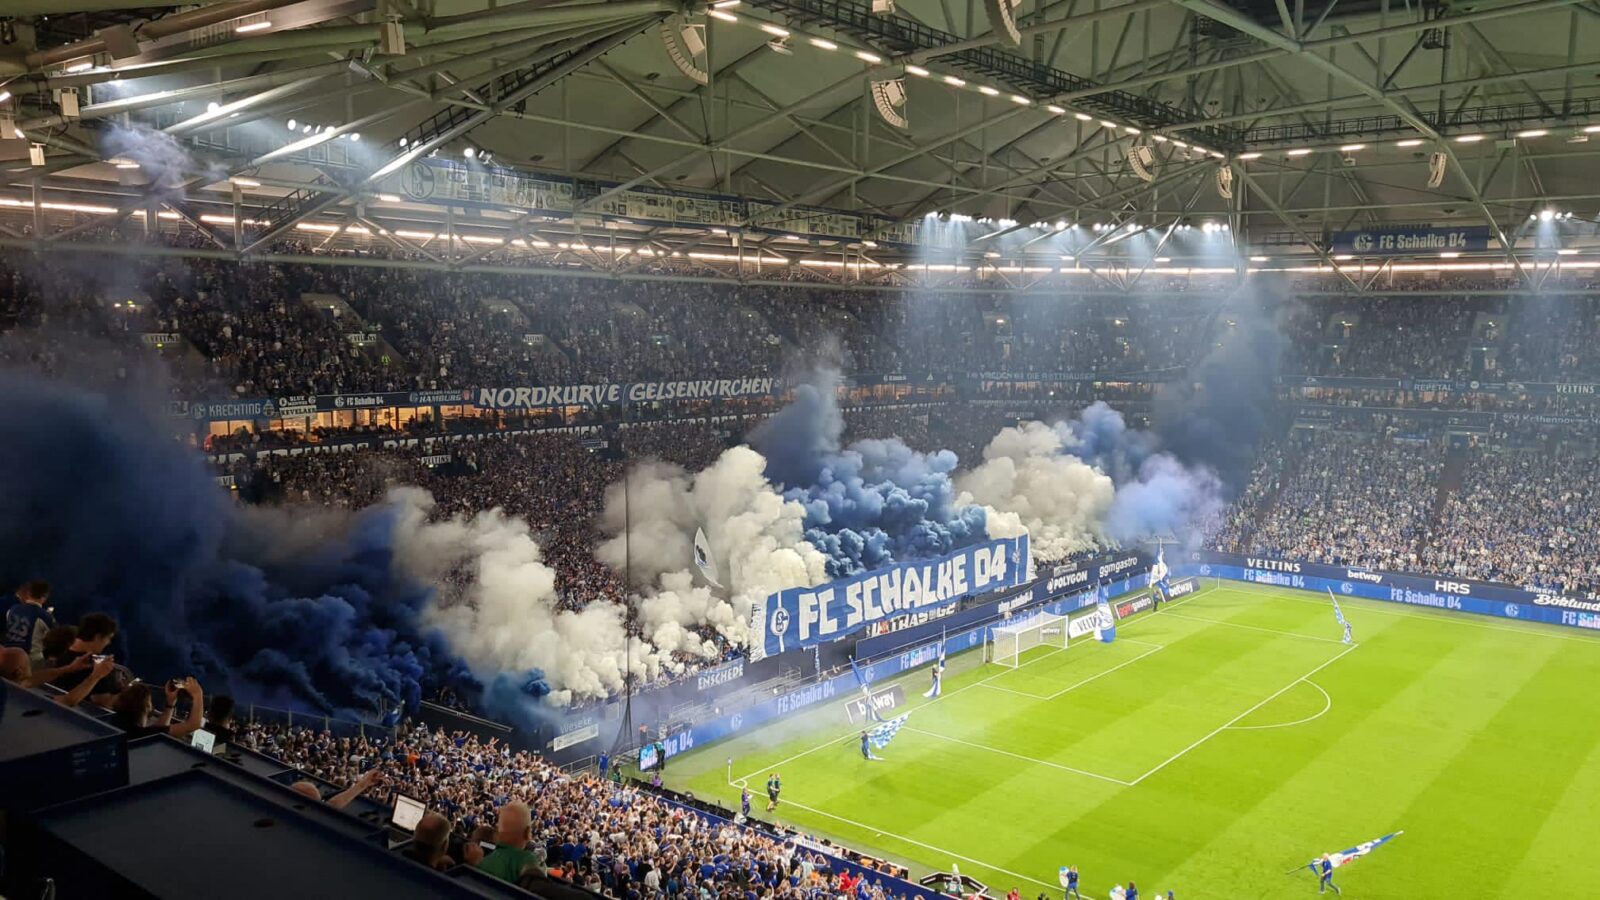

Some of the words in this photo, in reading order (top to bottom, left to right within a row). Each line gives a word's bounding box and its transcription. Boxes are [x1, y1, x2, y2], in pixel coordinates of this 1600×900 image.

[1379, 235, 1393, 249] FC
[1396, 234, 1445, 249] Schalke
[1449, 232, 1466, 247] 04
[479, 383, 620, 411] NORDKURVE
[629, 376, 773, 400] GELSENKIRCHEN
[1556, 384, 1595, 394] VELTINS
[209, 403, 261, 417] KRECHTING
[1247, 558, 1301, 573] VELTINS
[1053, 570, 1088, 590] POLYGON
[1243, 569, 1254, 581] FC
[1255, 570, 1290, 587] Schalke
[1292, 576, 1305, 588] 04
[1347, 569, 1382, 583] betway
[798, 588, 838, 641] FC
[846, 553, 968, 627] SCHALKE
[974, 544, 1007, 587] 04
[1435, 581, 1470, 595] HRS
[1391, 588, 1402, 601] FC
[1405, 590, 1445, 607] Schalke
[1447, 596, 1461, 609] 04
[1562, 611, 1576, 625] FC
[901, 654, 909, 671] FC
[910, 647, 937, 668] Schalke
[698, 664, 744, 690] ENSCHEDE
[777, 697, 788, 715] FC
[790, 685, 822, 710] Schalke
[823, 680, 835, 698] 04
[857, 691, 896, 716] btway
[680, 729, 694, 751] 04
